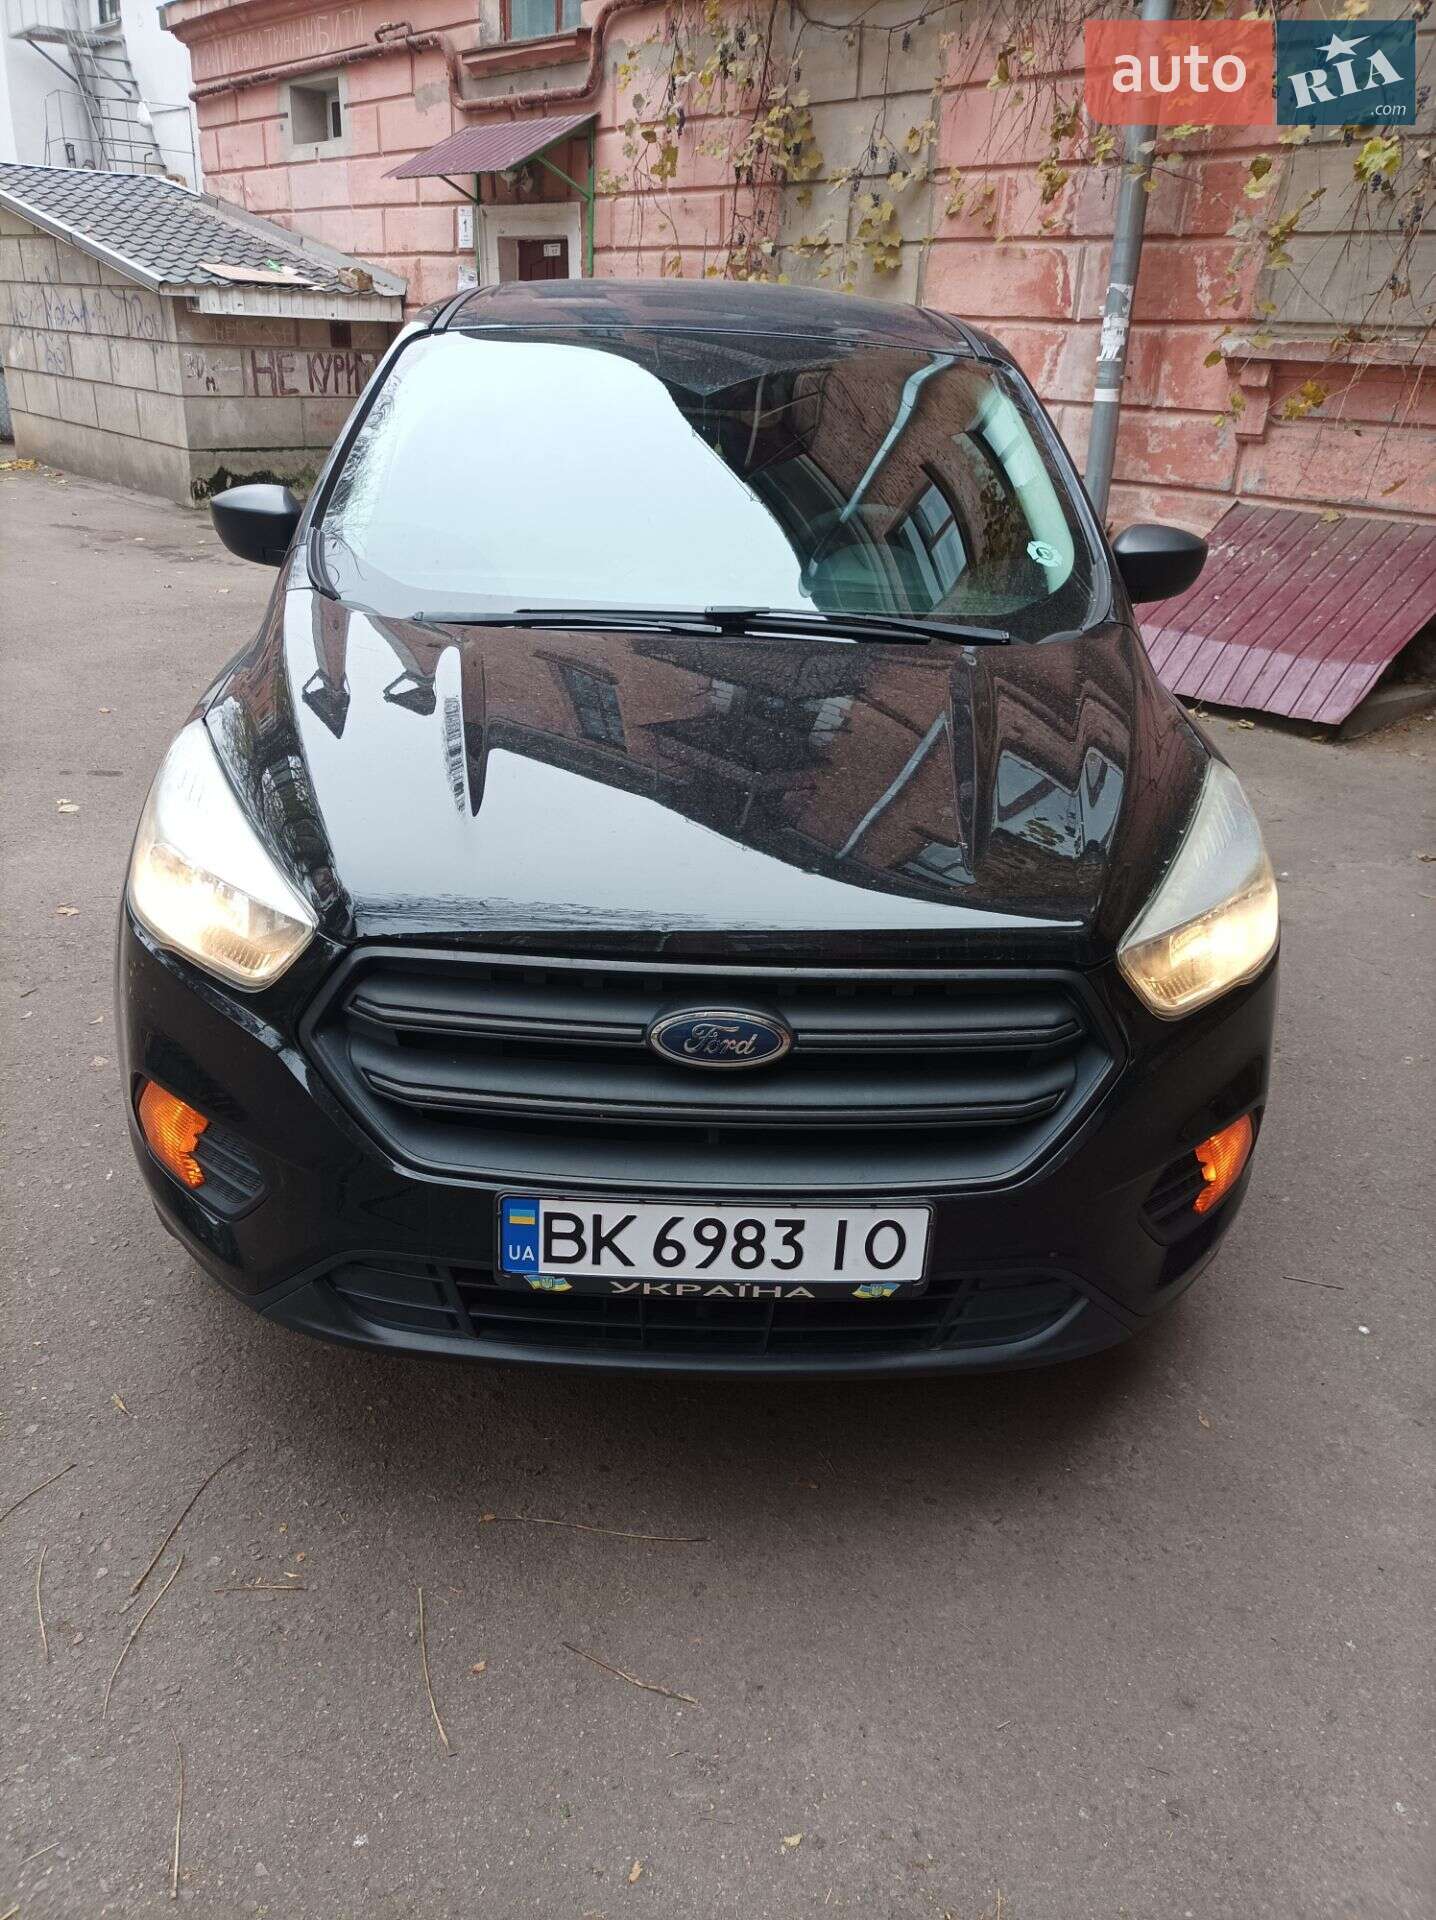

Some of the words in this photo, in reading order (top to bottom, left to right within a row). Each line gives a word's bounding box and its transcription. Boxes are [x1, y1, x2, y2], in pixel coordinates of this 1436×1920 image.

[251, 349, 299, 396] НЕ
[684, 1023, 758, 1055] Ford
[508, 1244, 535, 1262] UA
[543, 1211, 637, 1267] BK
[652, 1216, 806, 1270] 6983
[611, 1281, 816, 1299] УКРАЇНА
